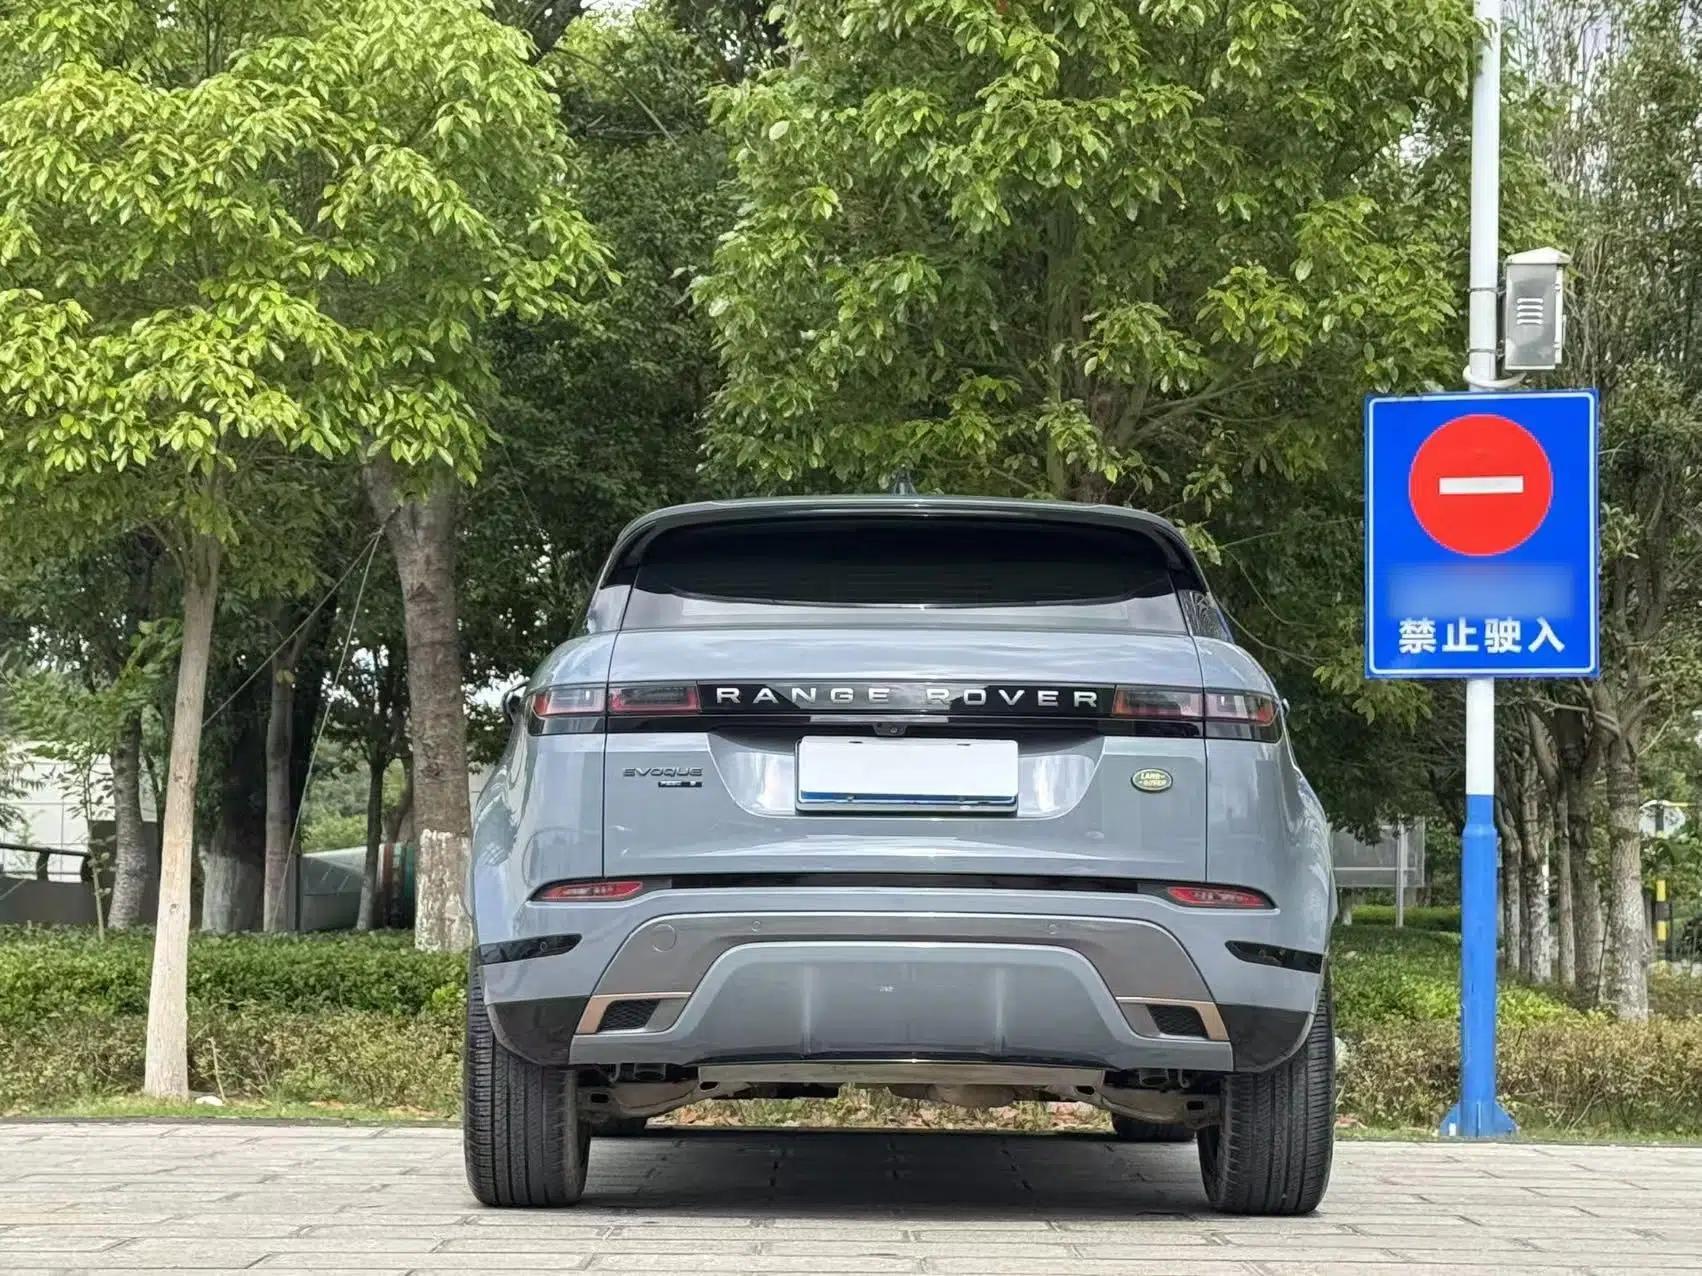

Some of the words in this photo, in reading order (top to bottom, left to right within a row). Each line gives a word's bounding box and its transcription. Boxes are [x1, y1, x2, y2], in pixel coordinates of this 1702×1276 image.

[1399, 616, 1566, 654] 禁止驶入
[716, 687, 888, 704] RANGE
[926, 689, 1098, 707] ROVER
[623, 767, 704, 777] EVOQUE
